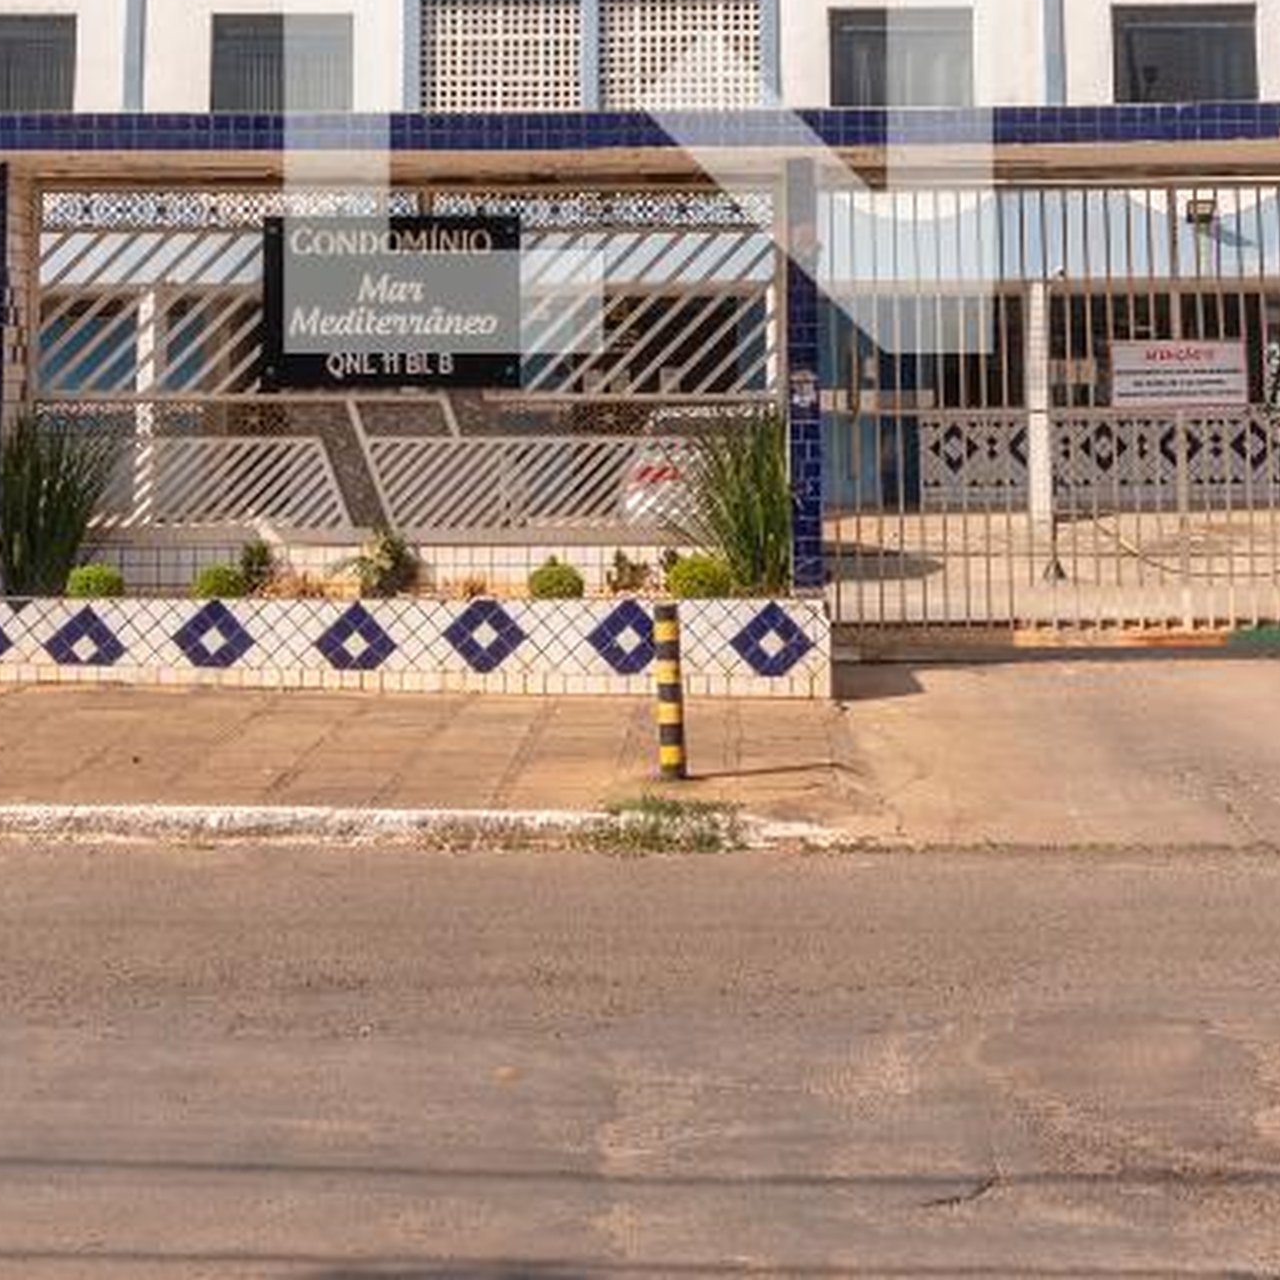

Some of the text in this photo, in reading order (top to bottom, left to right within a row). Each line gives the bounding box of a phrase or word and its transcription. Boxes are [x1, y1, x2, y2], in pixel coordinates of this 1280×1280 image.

[290, 225, 492, 255] CONDOMÍNIO
[357, 273, 425, 303] Mar
[289, 306, 498, 336] Mediterrâneo
[326, 352, 377, 378] QNL
[405, 352, 433, 374] BL
[439, 352, 454, 374] B
